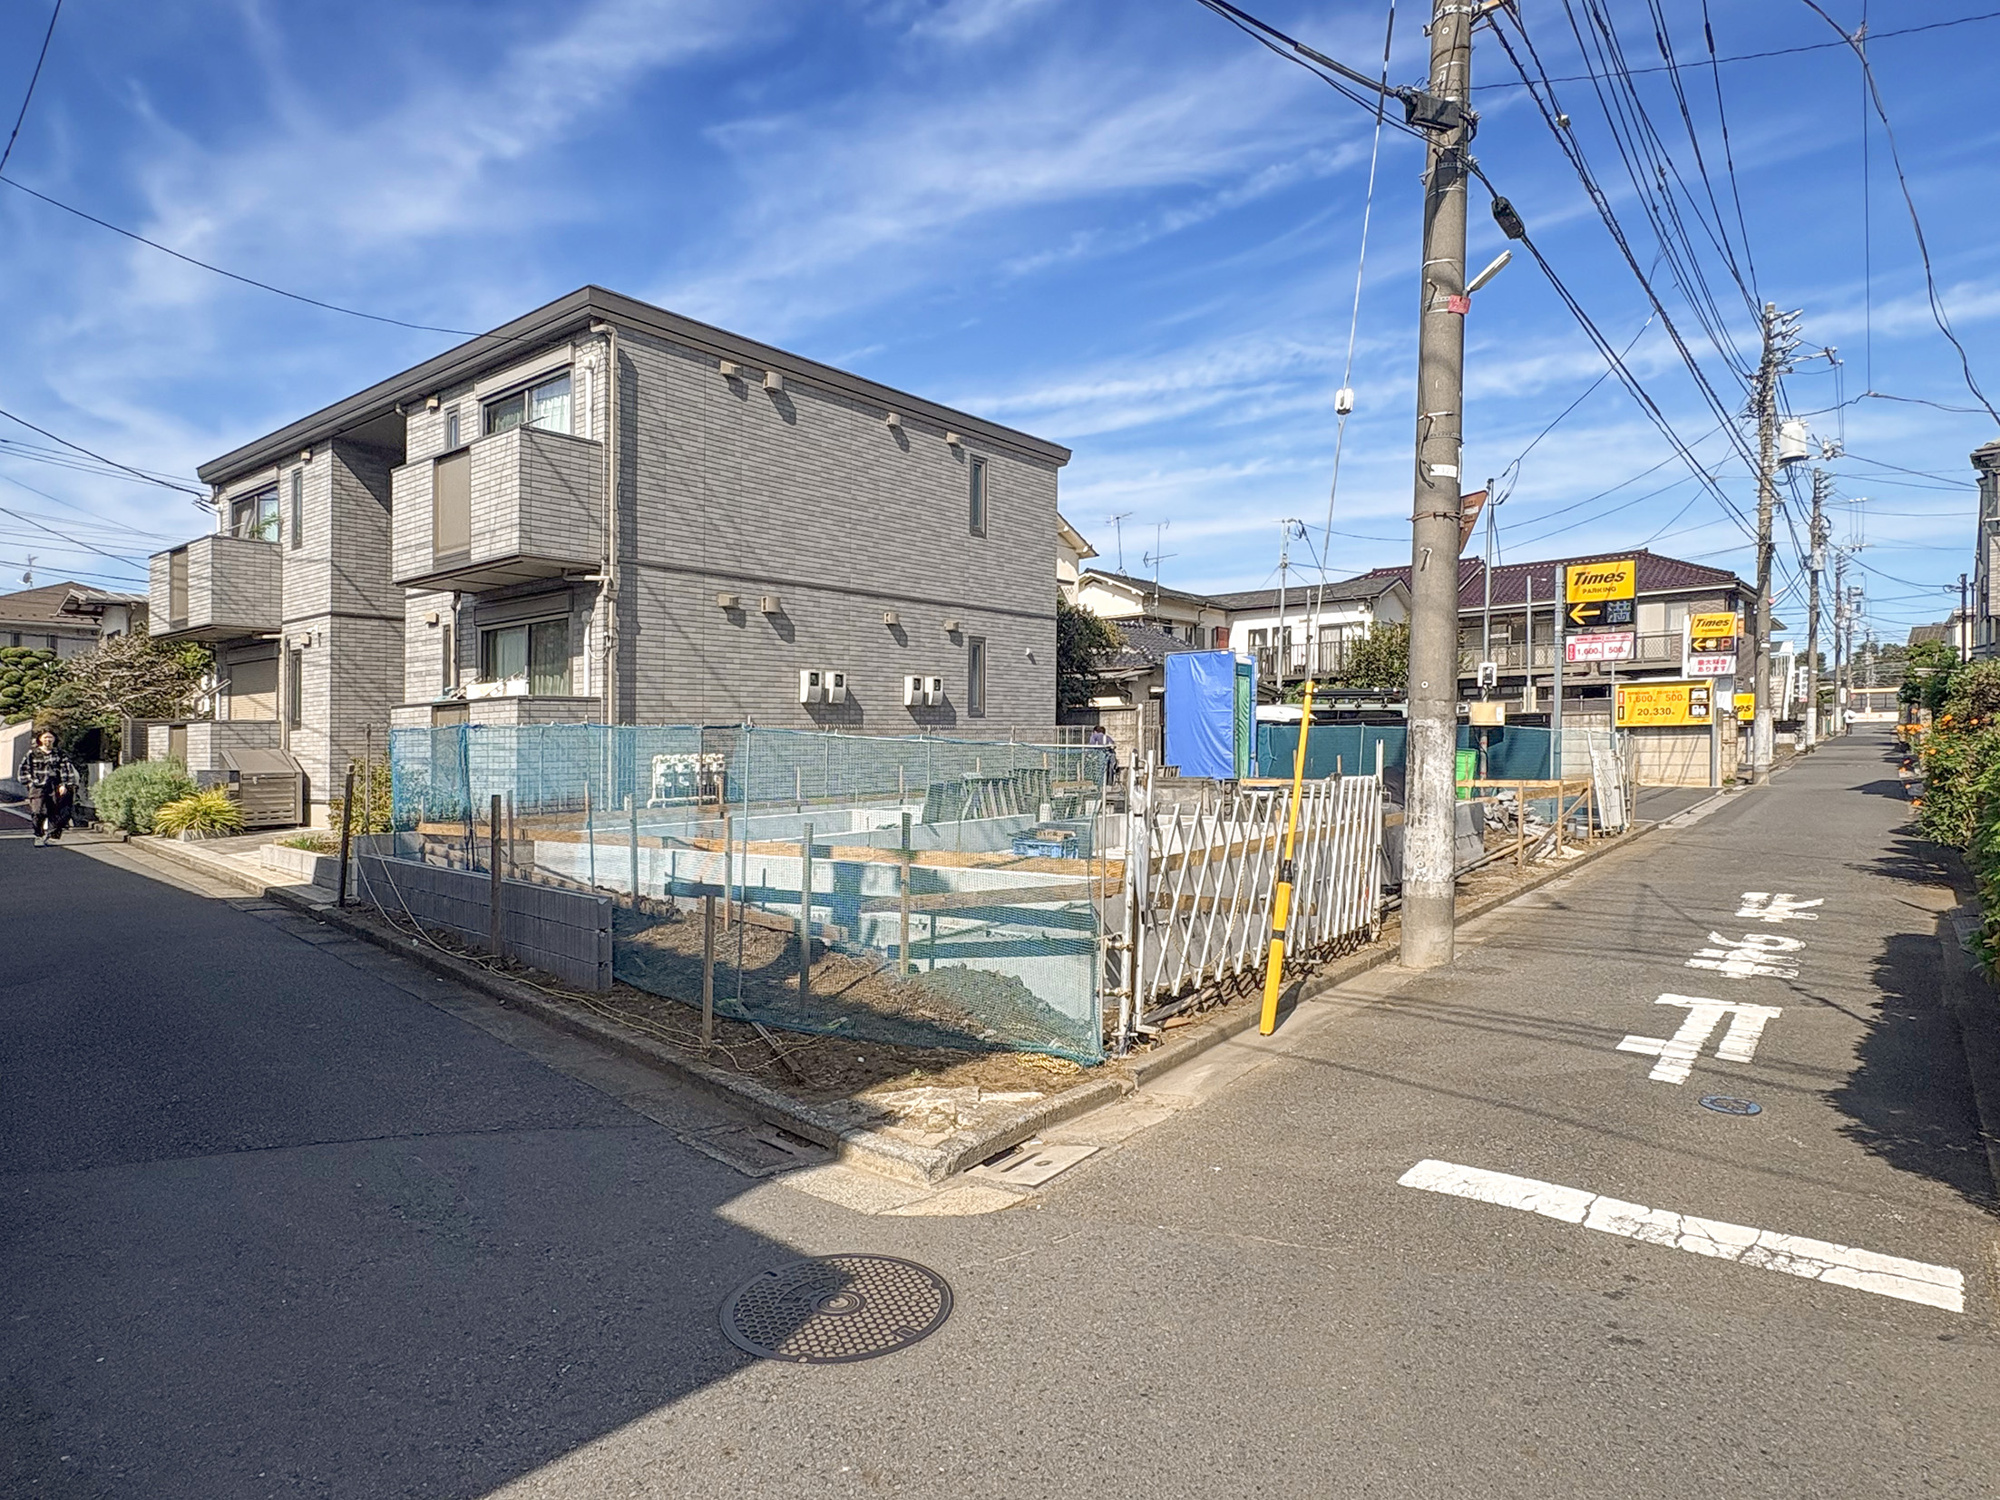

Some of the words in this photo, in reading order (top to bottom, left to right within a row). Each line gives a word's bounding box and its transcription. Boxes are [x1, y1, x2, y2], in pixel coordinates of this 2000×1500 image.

[1574, 571, 1626, 586] Times
[1582, 586, 1616, 594] PARKING
[1696, 619, 1730, 627] Times
